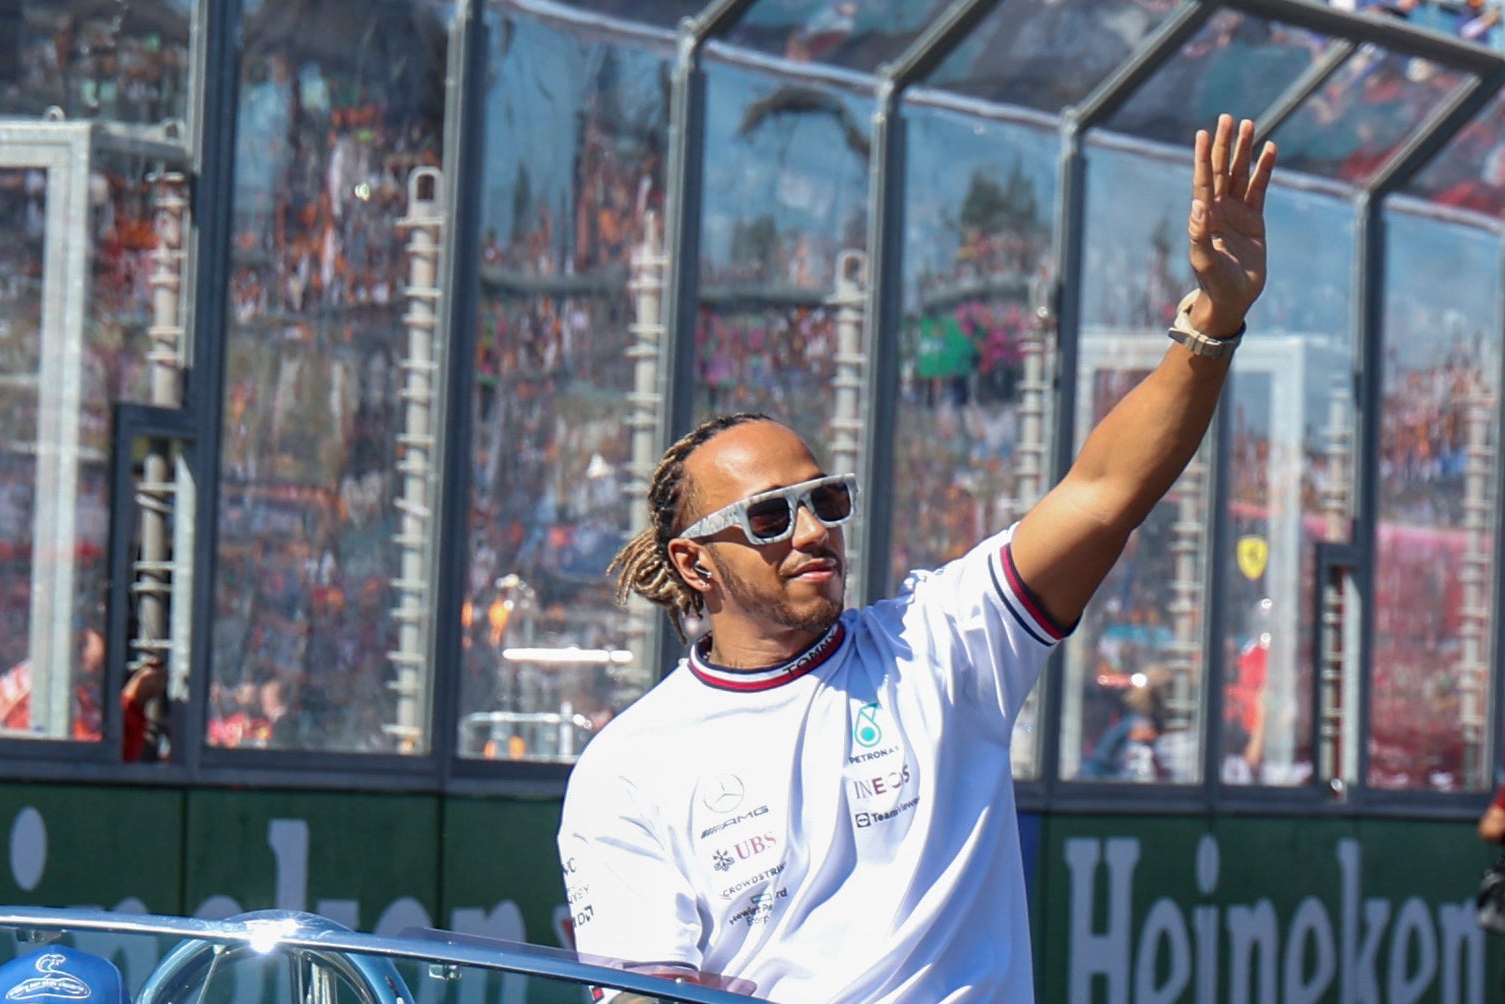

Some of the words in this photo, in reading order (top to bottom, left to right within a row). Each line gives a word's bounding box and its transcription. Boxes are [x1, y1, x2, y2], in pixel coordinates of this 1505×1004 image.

[853, 763, 911, 800] INEOS
[720, 804, 770, 832] AMG
[734, 831, 777, 860] UBS
[723, 862, 787, 897] CROWDSTRI
